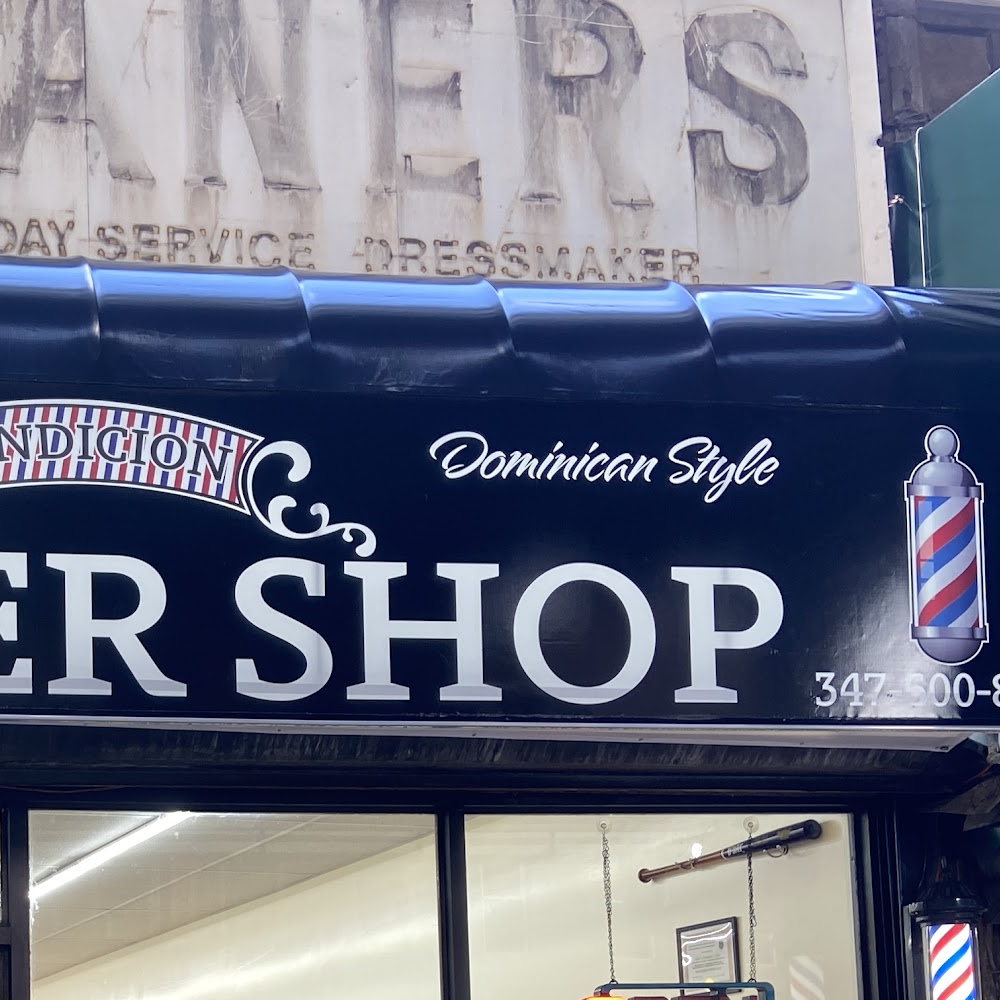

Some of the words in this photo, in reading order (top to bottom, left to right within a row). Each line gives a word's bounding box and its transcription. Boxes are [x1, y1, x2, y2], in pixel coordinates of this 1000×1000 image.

[95, 223, 316, 270] SERVICE
[362, 236, 701, 284] DRESSMAKER
[428, 430, 660, 485] Dominican
[667, 436, 782, 504] Style
[233, 556, 785, 706] SHOP
